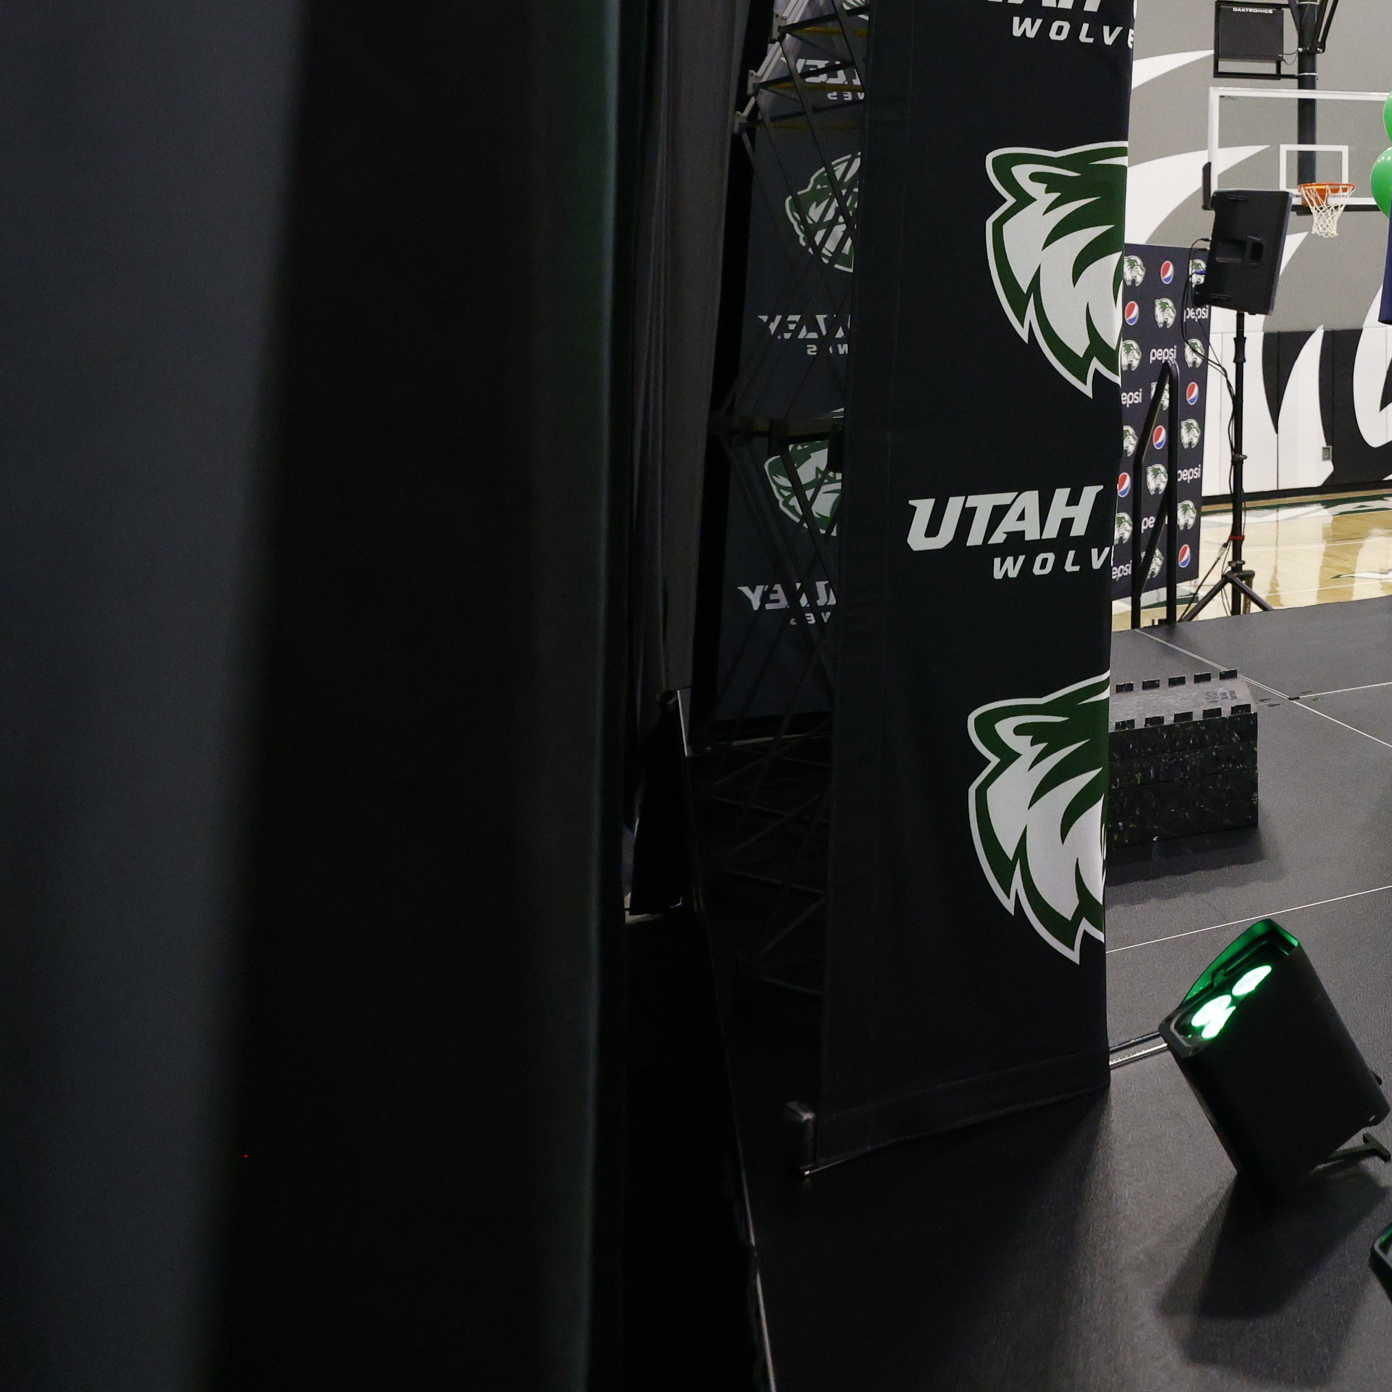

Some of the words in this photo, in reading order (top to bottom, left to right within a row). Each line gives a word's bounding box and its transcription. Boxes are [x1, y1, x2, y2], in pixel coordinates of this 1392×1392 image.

[1150, 346, 1177, 363] pepsi
[1121, 389, 1142, 407] epsi
[907, 485, 1104, 551] UTAH
[993, 546, 1112, 580] WOLV
[1112, 560, 1133, 582] epsi
